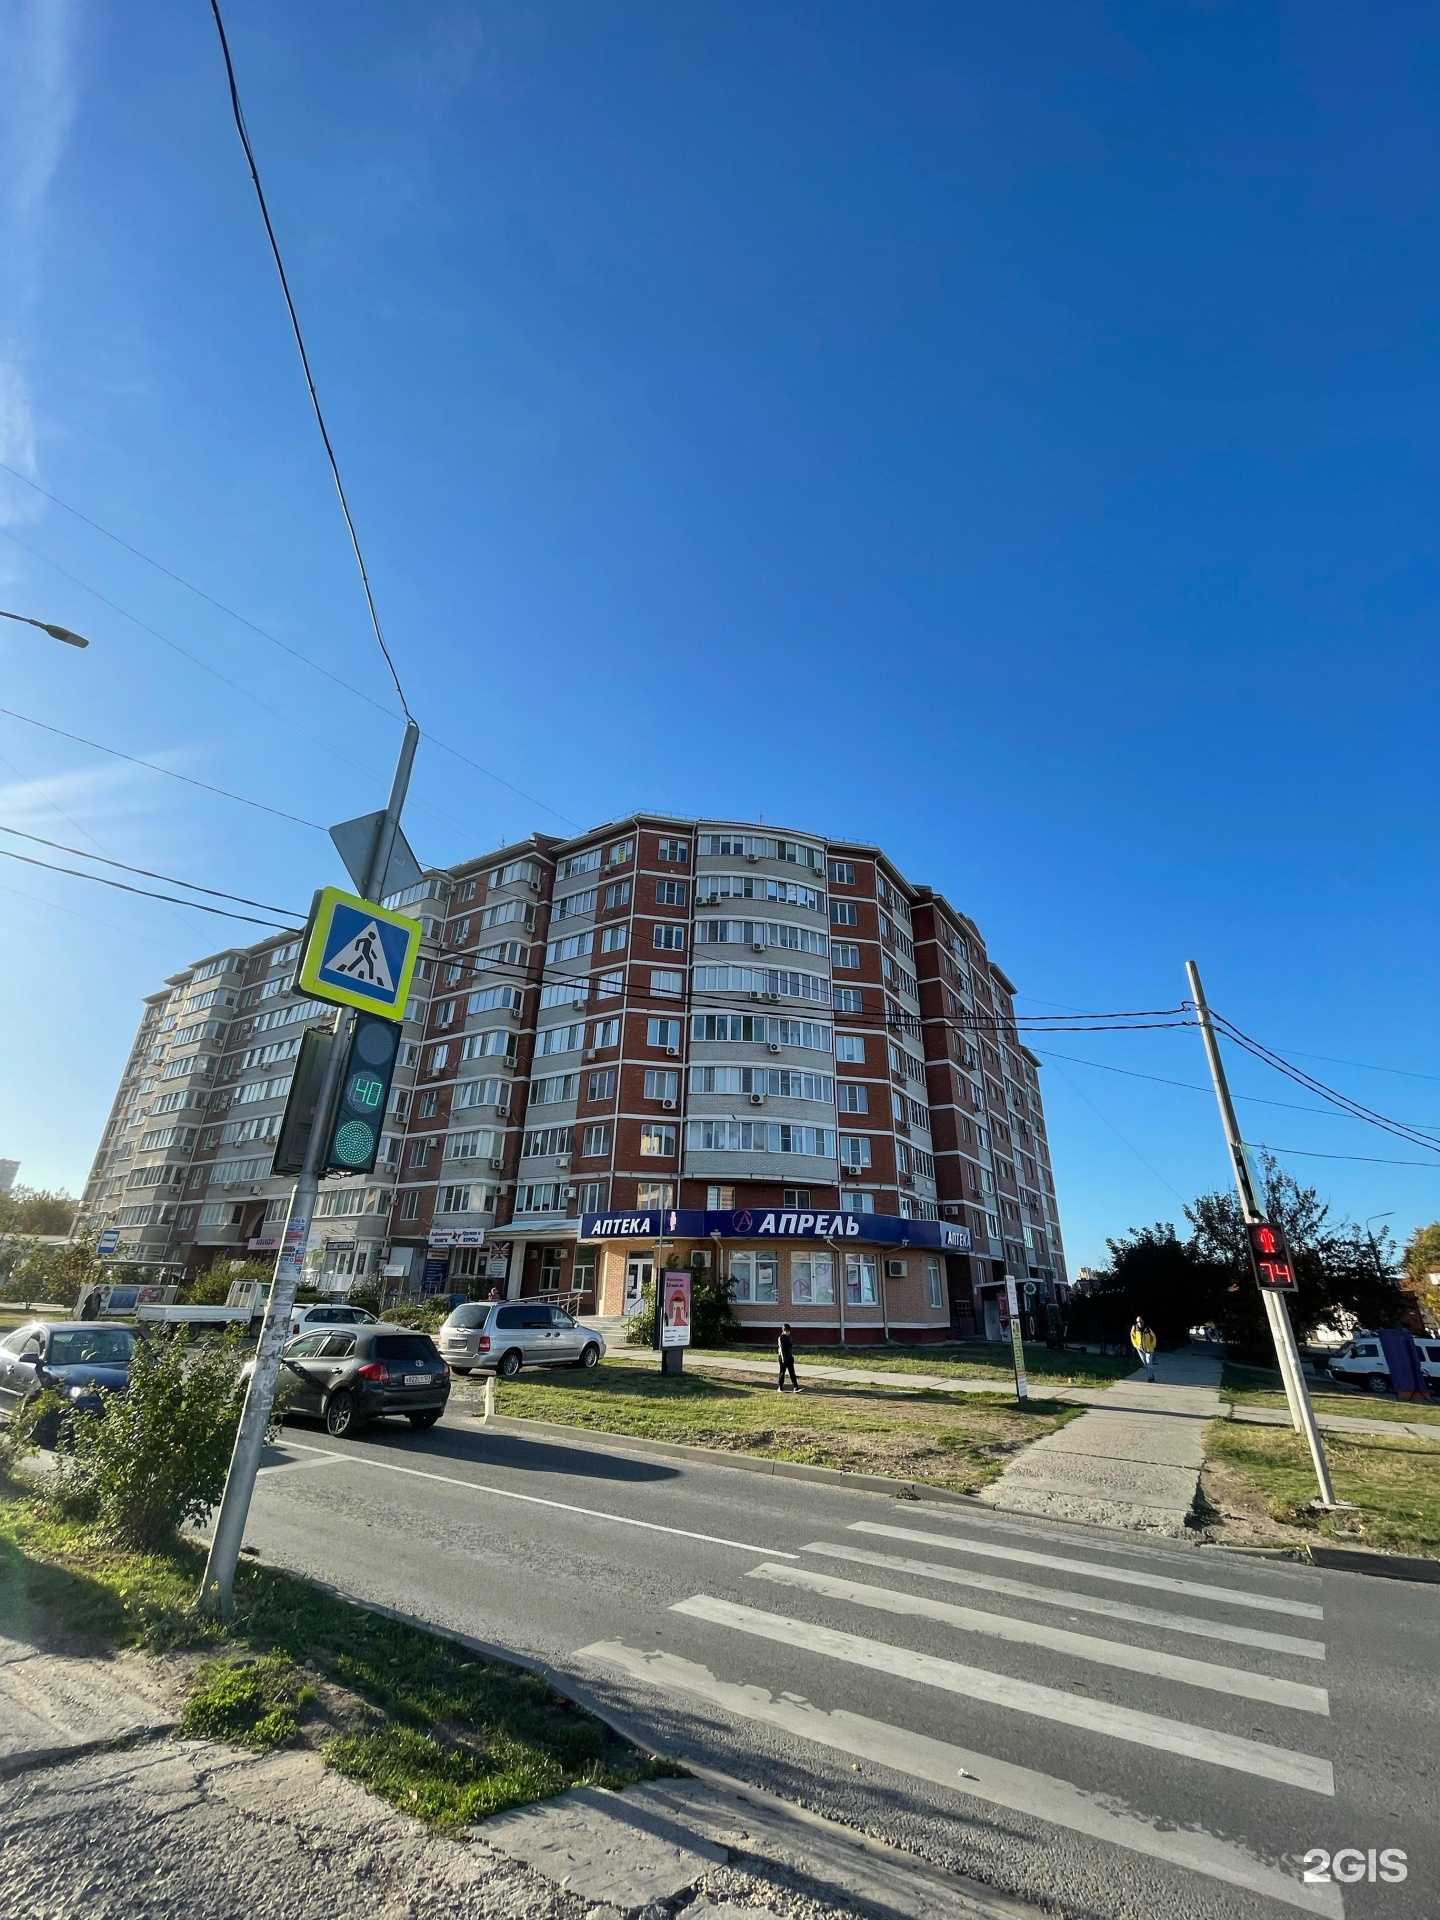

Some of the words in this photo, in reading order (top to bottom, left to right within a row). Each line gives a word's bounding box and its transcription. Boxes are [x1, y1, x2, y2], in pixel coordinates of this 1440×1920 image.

[356, 1079, 382, 1106] 40
[591, 1217, 650, 1235] АПТЕКА
[758, 1213, 860, 1236] АПРЕЛЬ
[947, 1231, 971, 1248] АПТЕКА
[1259, 1262, 1291, 1283] 74
